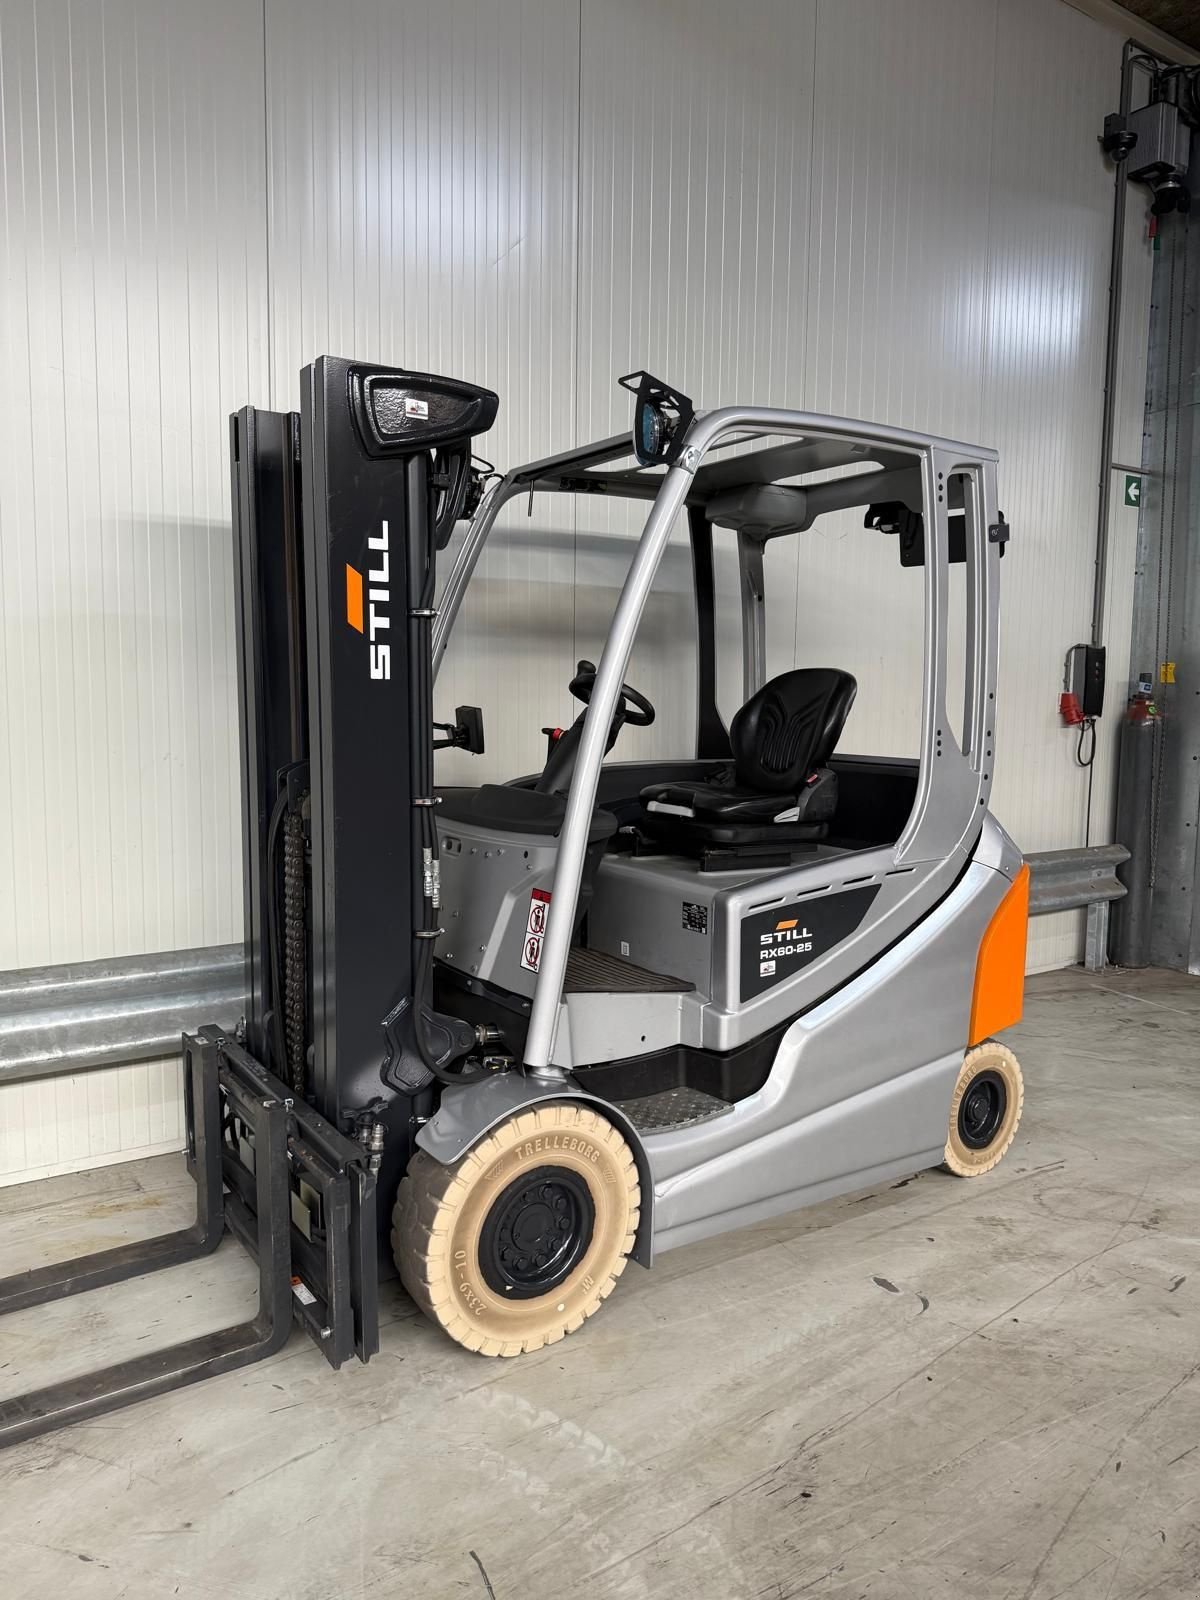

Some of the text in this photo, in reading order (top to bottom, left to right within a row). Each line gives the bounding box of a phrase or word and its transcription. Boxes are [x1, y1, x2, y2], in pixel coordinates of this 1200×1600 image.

[368, 520, 391, 680] STILL
[760, 928, 813, 945] STILL
[760, 942, 813, 959] RX60-25
[514, 1135, 600, 1162] TRELLEBORG
